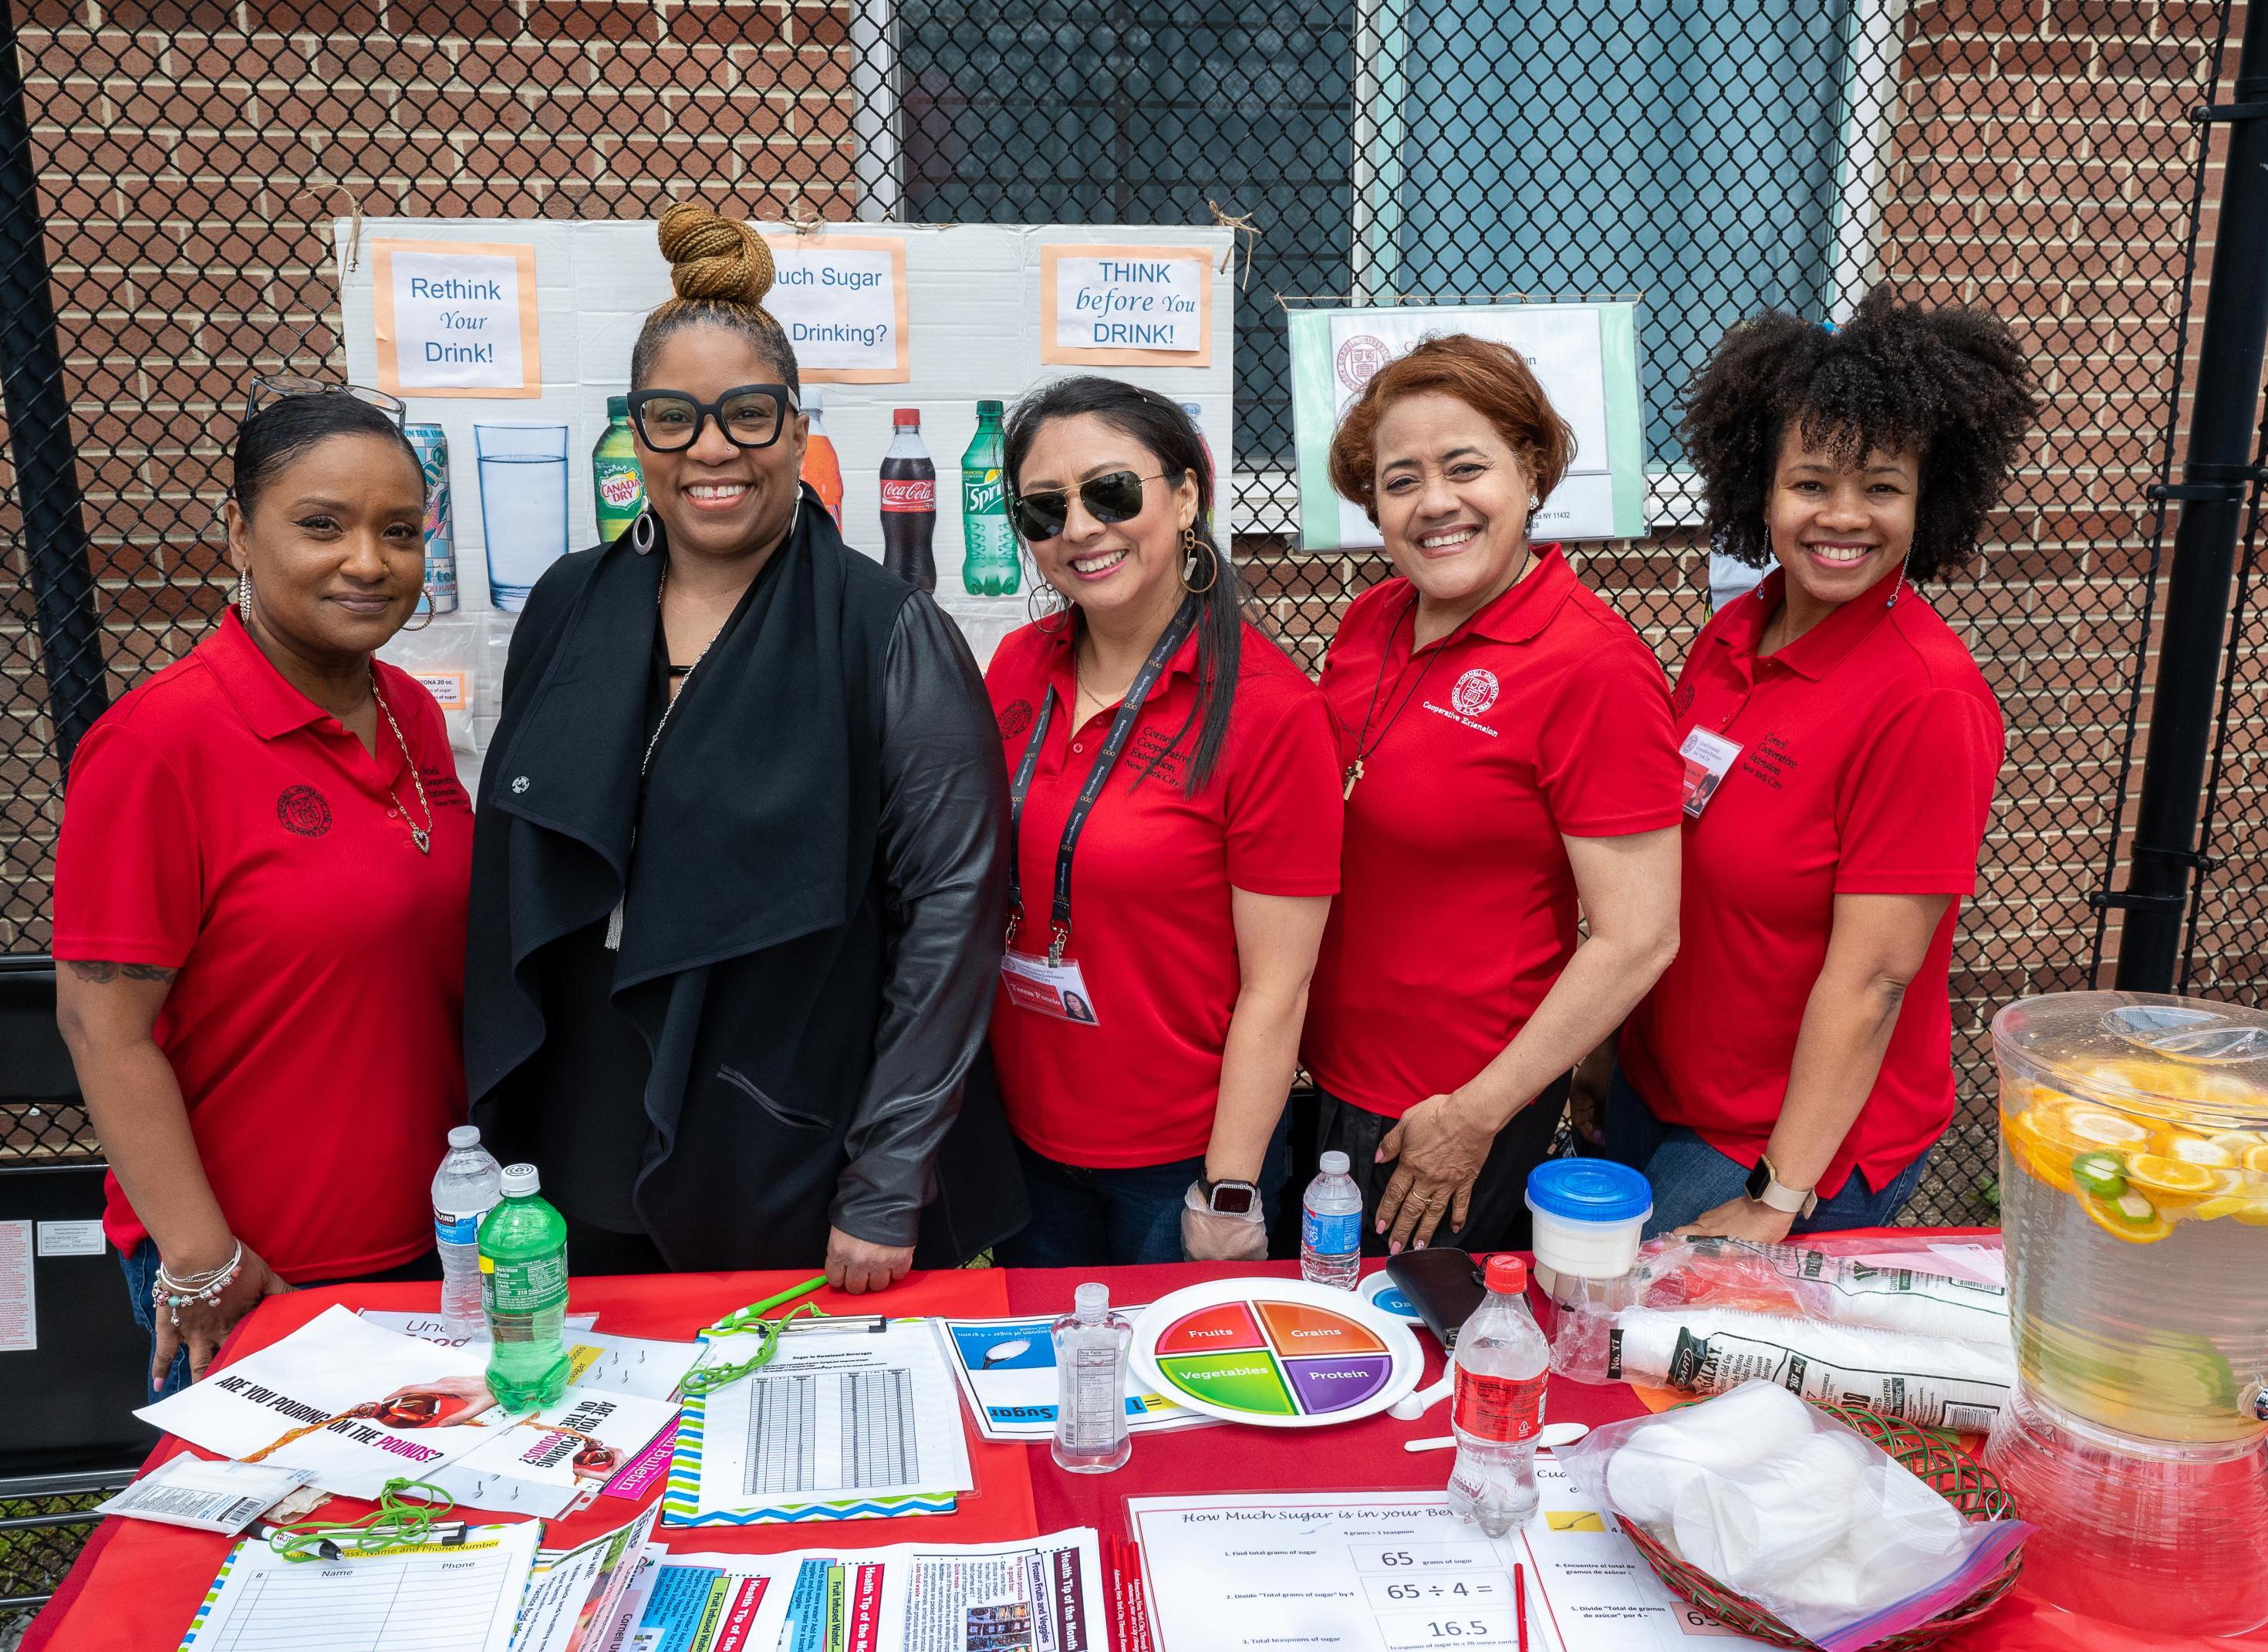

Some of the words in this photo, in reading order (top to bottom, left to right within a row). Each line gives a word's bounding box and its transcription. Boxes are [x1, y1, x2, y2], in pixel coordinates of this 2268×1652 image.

[822, 268, 882, 290] Sugar
[1099, 263, 1170, 283] THINK
[411, 278, 501, 300] Rethink
[1077, 286, 1153, 317] before
[1163, 296, 1196, 312] You
[440, 311, 488, 330] Your
[793, 323, 887, 345] Drinking?
[1094, 323, 1174, 344] DRINK!
[425, 342, 493, 363] Drink!
[601, 479, 641, 497] CANADA
[613, 489, 633, 502] DRY
[970, 485, 1001, 512] Spri
[1459, 671, 1482, 684] CORNELL
[1423, 701, 1460, 721] Cooperative
[1461, 717, 1498, 737] Extension
[1764, 733, 1789, 748] Cornell
[1749, 752, 1780, 776] Extension
[1757, 743, 1797, 769] Cooperative
[1188, 1327, 1234, 1338] Fruits
[1291, 1328, 1342, 1338] Grains
[1612, 1339, 1620, 1353] Y7
[1180, 1366, 1268, 1380] Vegetables
[1309, 1370, 1369, 1381] Protein
[1720, 1364, 1730, 1377] Cold
[1733, 1354, 1743, 1376] Plástico
[1753, 1356, 1763, 1378] Boisson
[1794, 1364, 1802, 1373] mL
[1790, 1374, 1800, 1390] 207
[575, 1401, 598, 1412] ON
[597, 1401, 617, 1417] ARE
[990, 1407, 1053, 1419] Sugar
[214, 1376, 251, 1393] ARE
[241, 1385, 278, 1404] YOU
[268, 1397, 332, 1426] POURING
[326, 1418, 356, 1437] ON
[346, 1425, 384, 1444] THE
[376, 1435, 445, 1465] POUNDS?
[558, 1414, 586, 1429] THE
[575, 1414, 602, 1434] YOU
[518, 1431, 569, 1466] POUNDS?
[536, 1436, 582, 1468] POURING
[619, 1447, 674, 1491] Bulletin
[1182, 1513, 1220, 1522] How
[1226, 1510, 1276, 1520] Much
[1279, 1511, 1333, 1522] Sugar
[1357, 1509, 1379, 1519] in
[1382, 1508, 1422, 1519] your
[415, 1543, 441, 1553] Phone
[458, 1539, 499, 1550] Number
[592, 1544, 606, 1561] You
[1061, 1552, 1072, 1579] Health
[1382, 1552, 1413, 1566] 65
[321, 1569, 353, 1577] Name
[441, 1561, 475, 1569] Phone
[582, 1562, 596, 1579] will:
[1032, 1562, 1042, 1583] Frozen
[863, 1567, 876, 1594] Health
[1063, 1579, 1073, 1593] Tip
[741, 1580, 761, 1606] Health
[1035, 1583, 1045, 1601] Fruits
[1064, 1595, 1074, 1604] of
[1388, 1584, 1420, 1599] 65
[1453, 1583, 1469, 1596] 4
[712, 1593, 723, 1607] Fruit
[795, 1591, 804, 1610] Veggies
[859, 1596, 872, 1610] Tip
[521, 1608, 533, 1621] food
[733, 1610, 749, 1623] Tip
[832, 1598, 841, 1622] Infused
[860, 1613, 870, 1621] of
[1065, 1603, 1075, 1620] the
[615, 1613, 633, 1640] Cornell
[704, 1607, 717, 1636] Infused
[731, 1625, 741, 1634] of
[1039, 1615, 1049, 1643] Veggies
[1428, 1621, 1487, 1637] 16.5
[858, 1623, 869, 1639] the
[1066, 1620, 1078, 1650] Month
[723, 1637, 737, 1652] the
